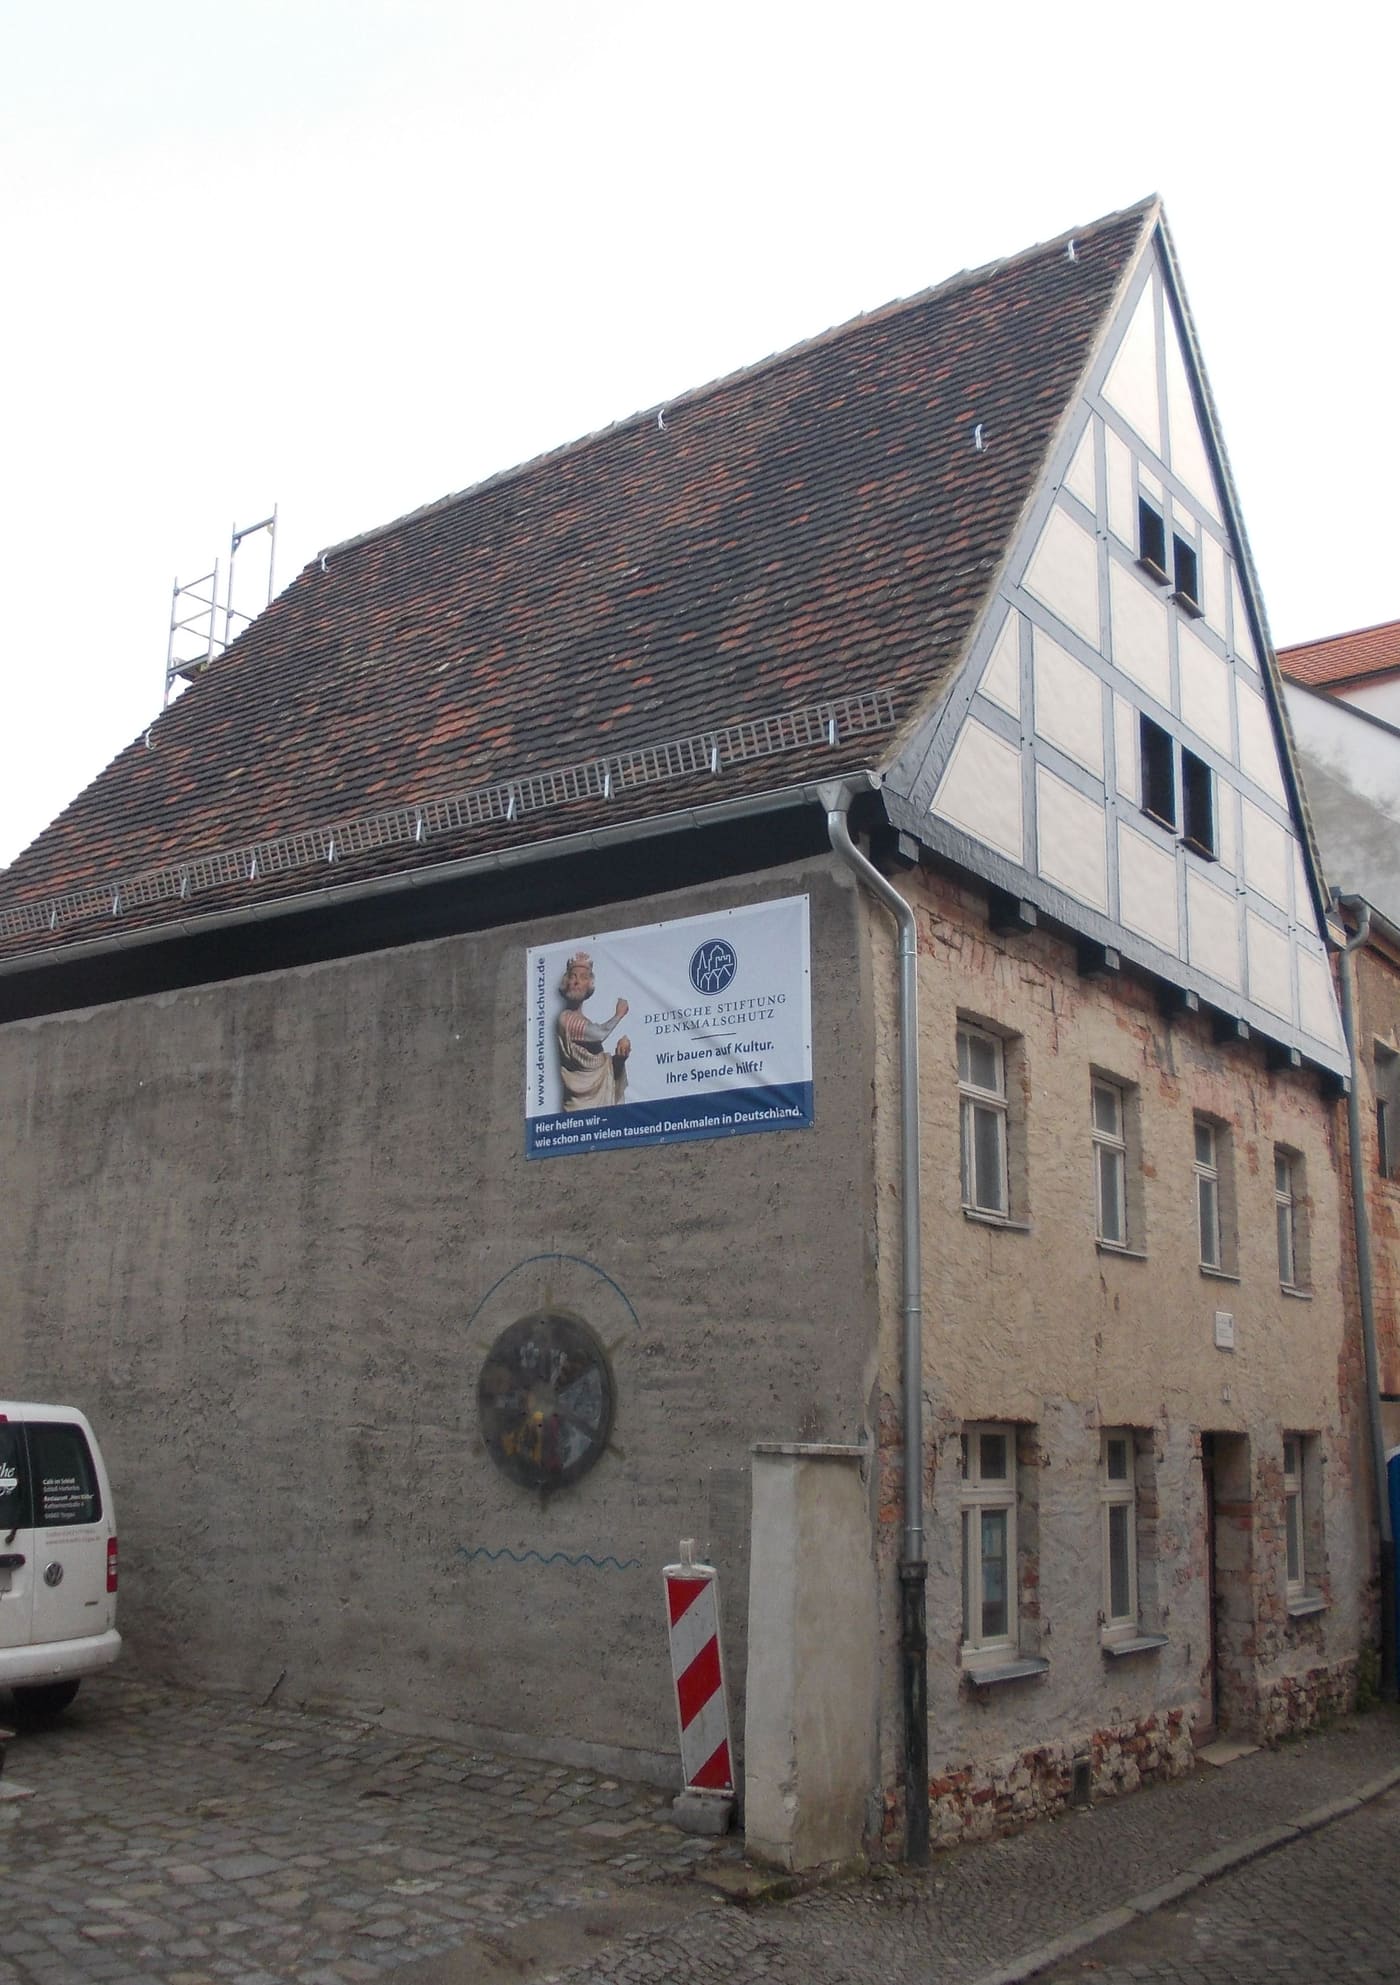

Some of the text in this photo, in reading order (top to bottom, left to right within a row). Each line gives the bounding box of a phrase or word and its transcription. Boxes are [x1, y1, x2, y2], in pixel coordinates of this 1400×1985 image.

[644, 993, 787, 1025] DEUTSCHE STIFTUNG
[655, 1008, 775, 1035] DENKMALSCHUTZ
[536, 957, 546, 1106] www.denkmalschutz.de
[656, 1040, 775, 1065] Wir bauen auf Kultur.
[666, 1061, 763, 1084] Ihre Spende hilft!
[535, 1104, 803, 1148] wie schon an vielen tausend Denkmalen in Deutschland.
[536, 1120, 554, 1132] Hier
[555, 1118, 584, 1130] helfen
